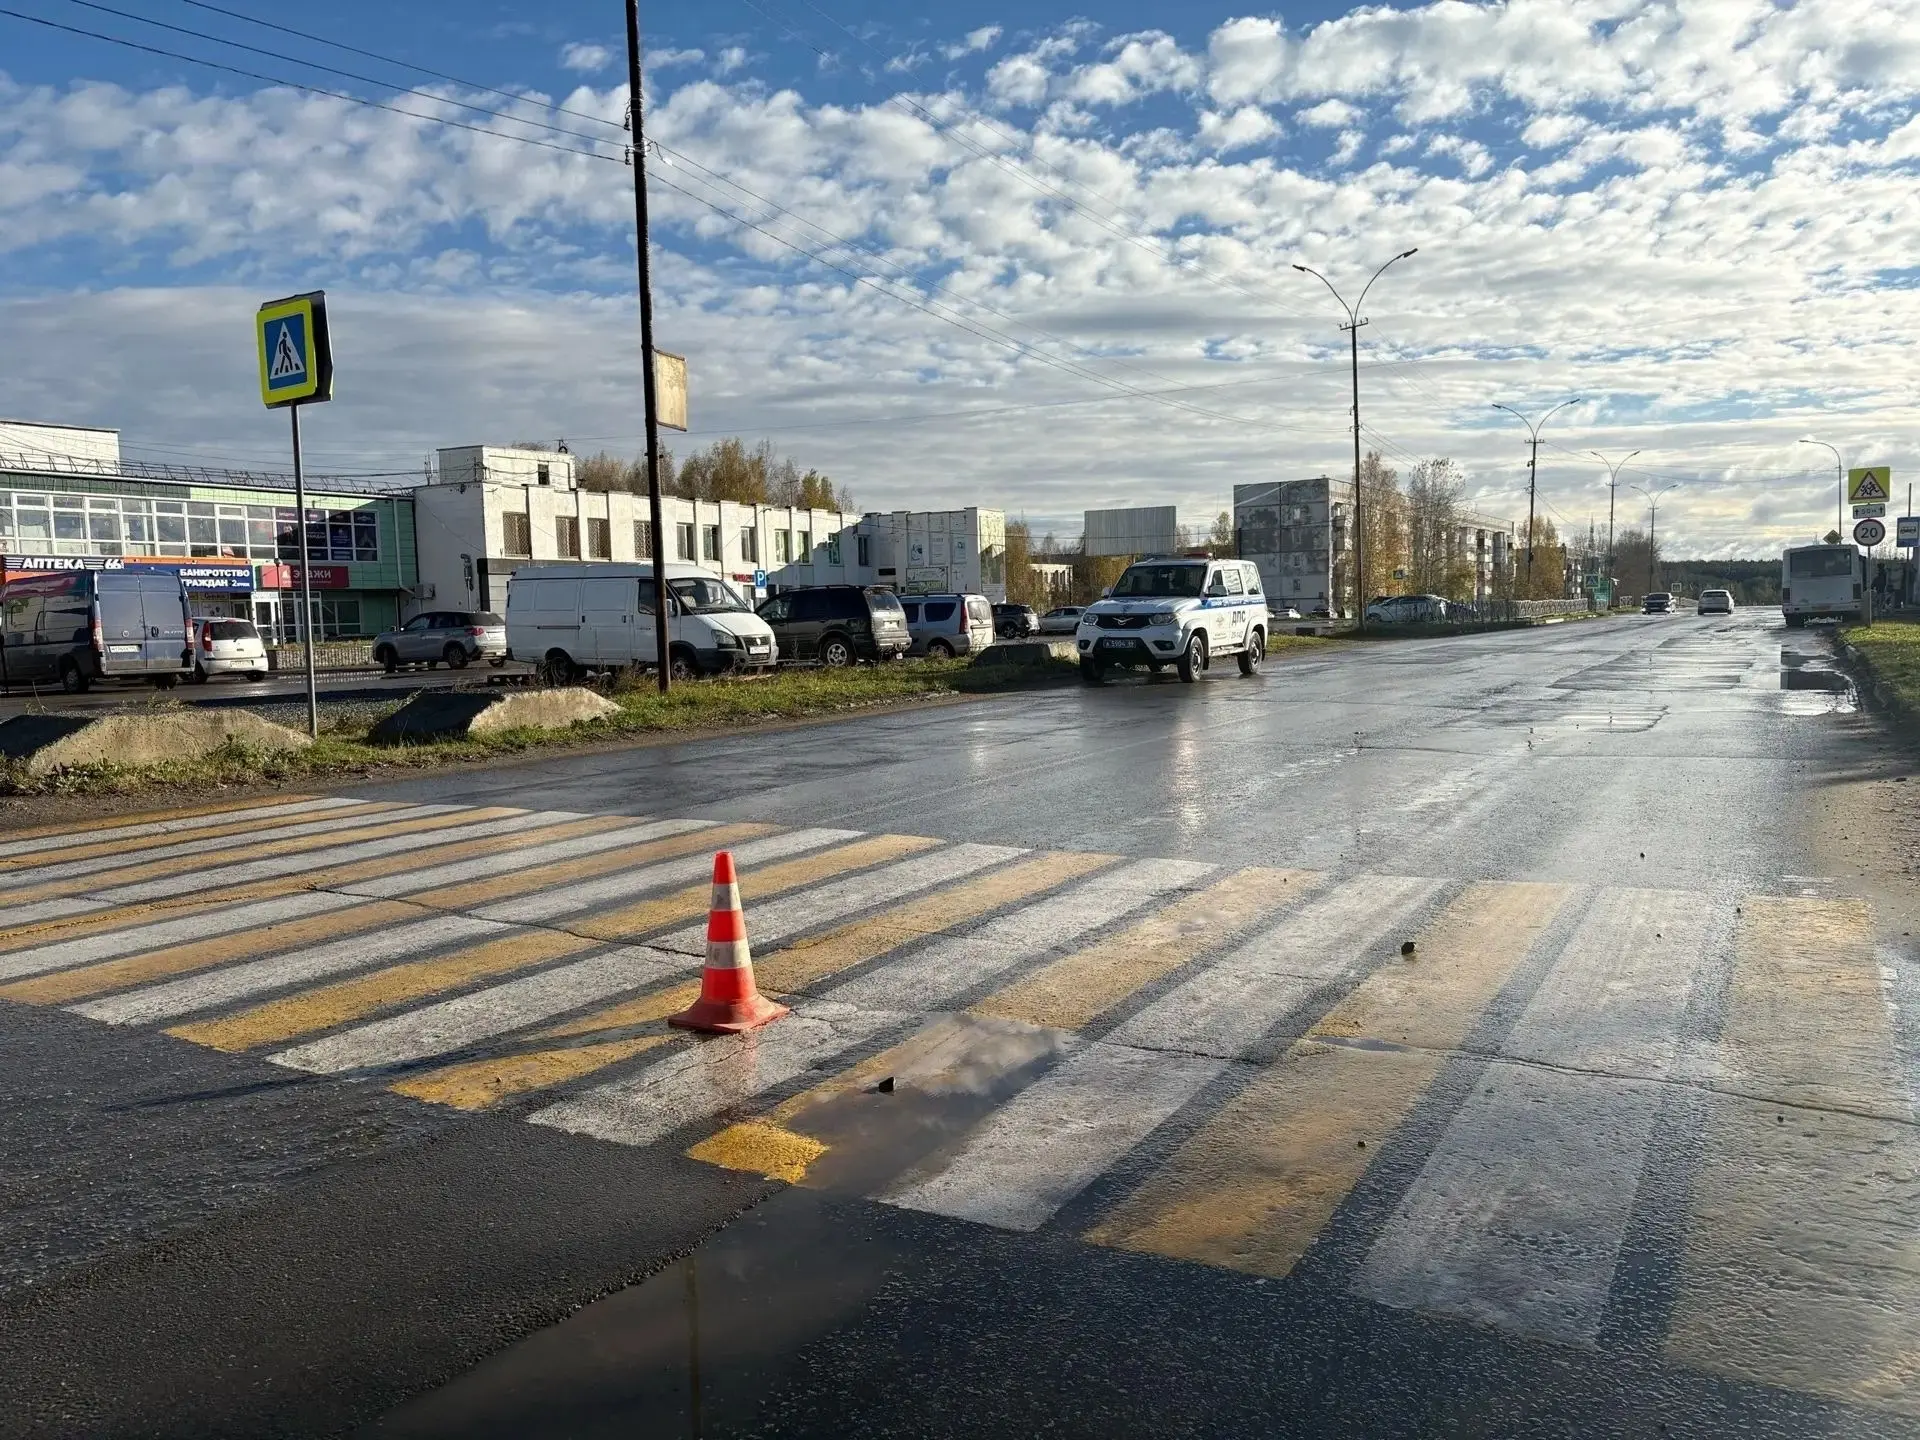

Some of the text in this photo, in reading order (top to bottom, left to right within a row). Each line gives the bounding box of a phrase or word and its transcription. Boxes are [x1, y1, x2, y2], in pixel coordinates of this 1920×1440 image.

[1861, 527, 1878, 538] 20
[22, 558, 85, 570] АПТЕКА
[180, 569, 250, 577] БАНКРОТСТВО
[757, 571, 765, 586] P
[181, 579, 228, 588] ГРАЖДАН
[1232, 610, 1246, 626] ДПС
